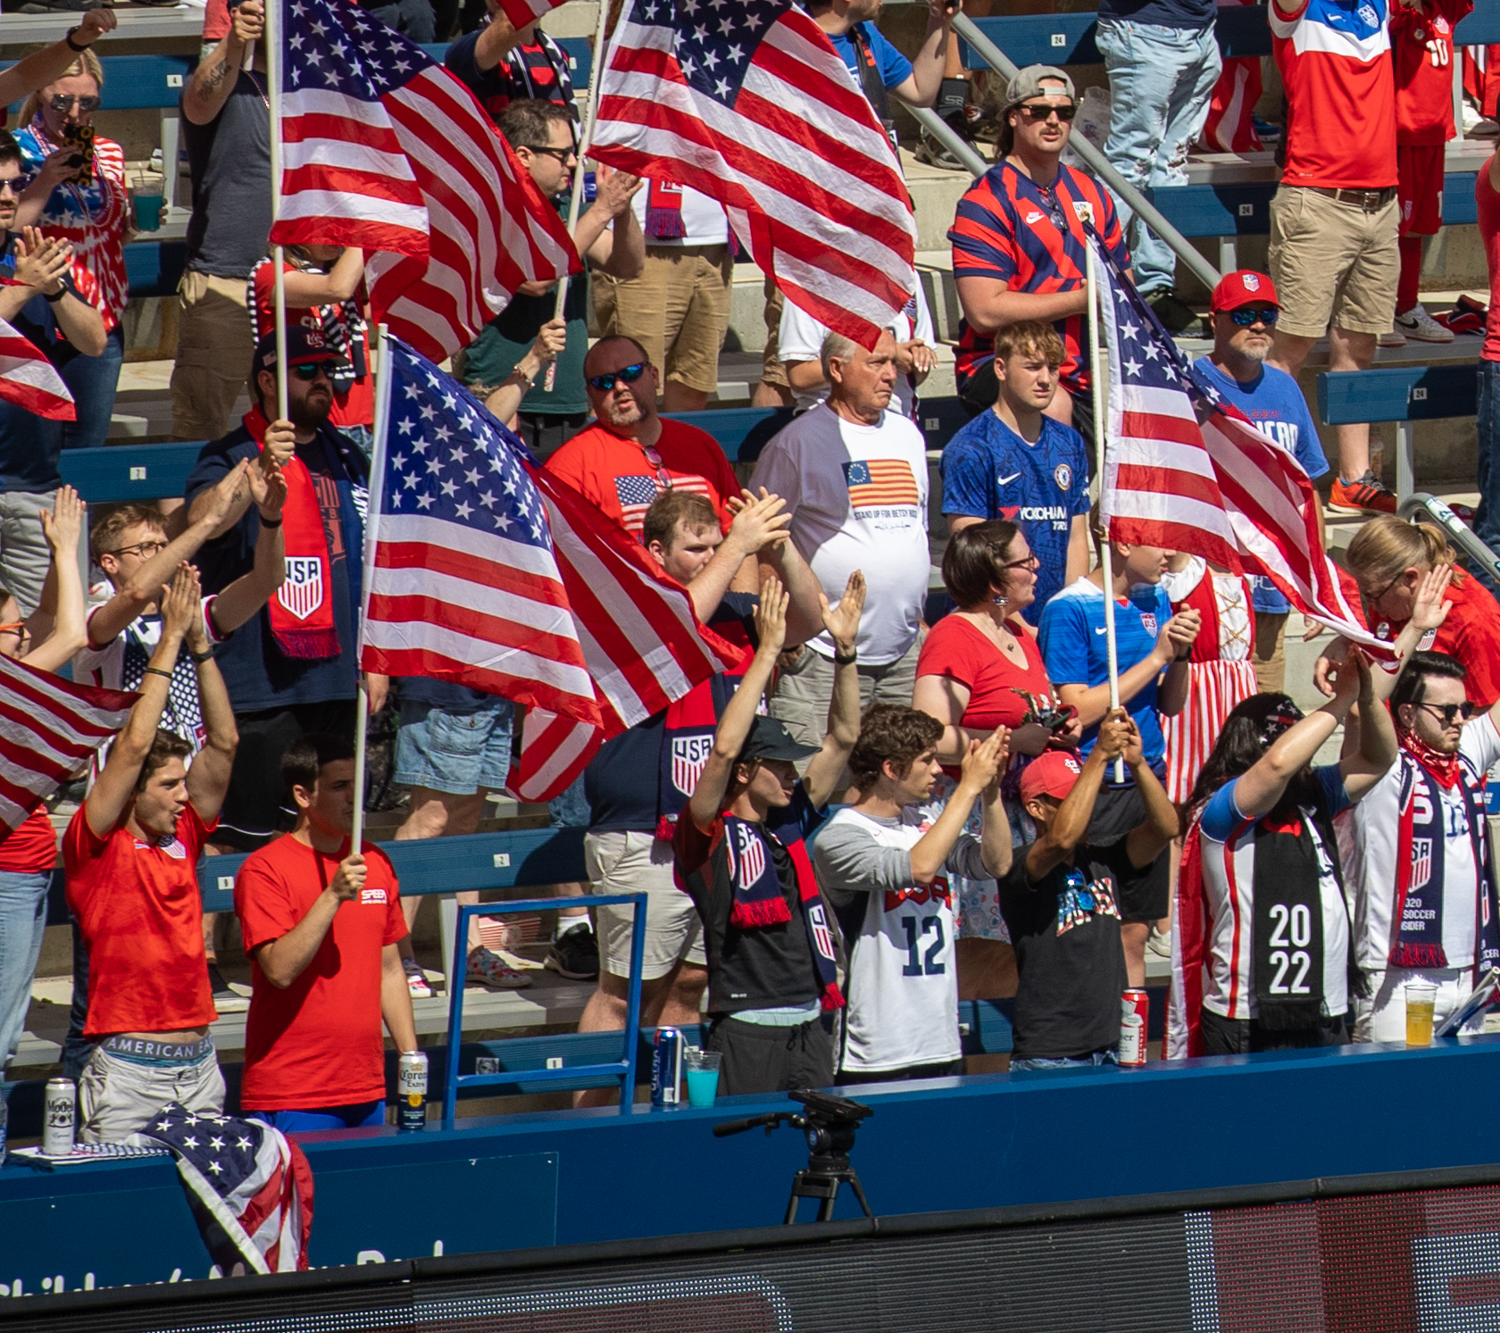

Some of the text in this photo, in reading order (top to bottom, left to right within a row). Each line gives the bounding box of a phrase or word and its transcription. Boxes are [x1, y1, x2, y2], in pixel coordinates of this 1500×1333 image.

[674, 737, 713, 762] USA
[900, 915, 946, 977] 12
[1270, 903, 1310, 946] 20
[1269, 952, 1311, 995] 22
[106, 1038, 195, 1058] AMERICAN
